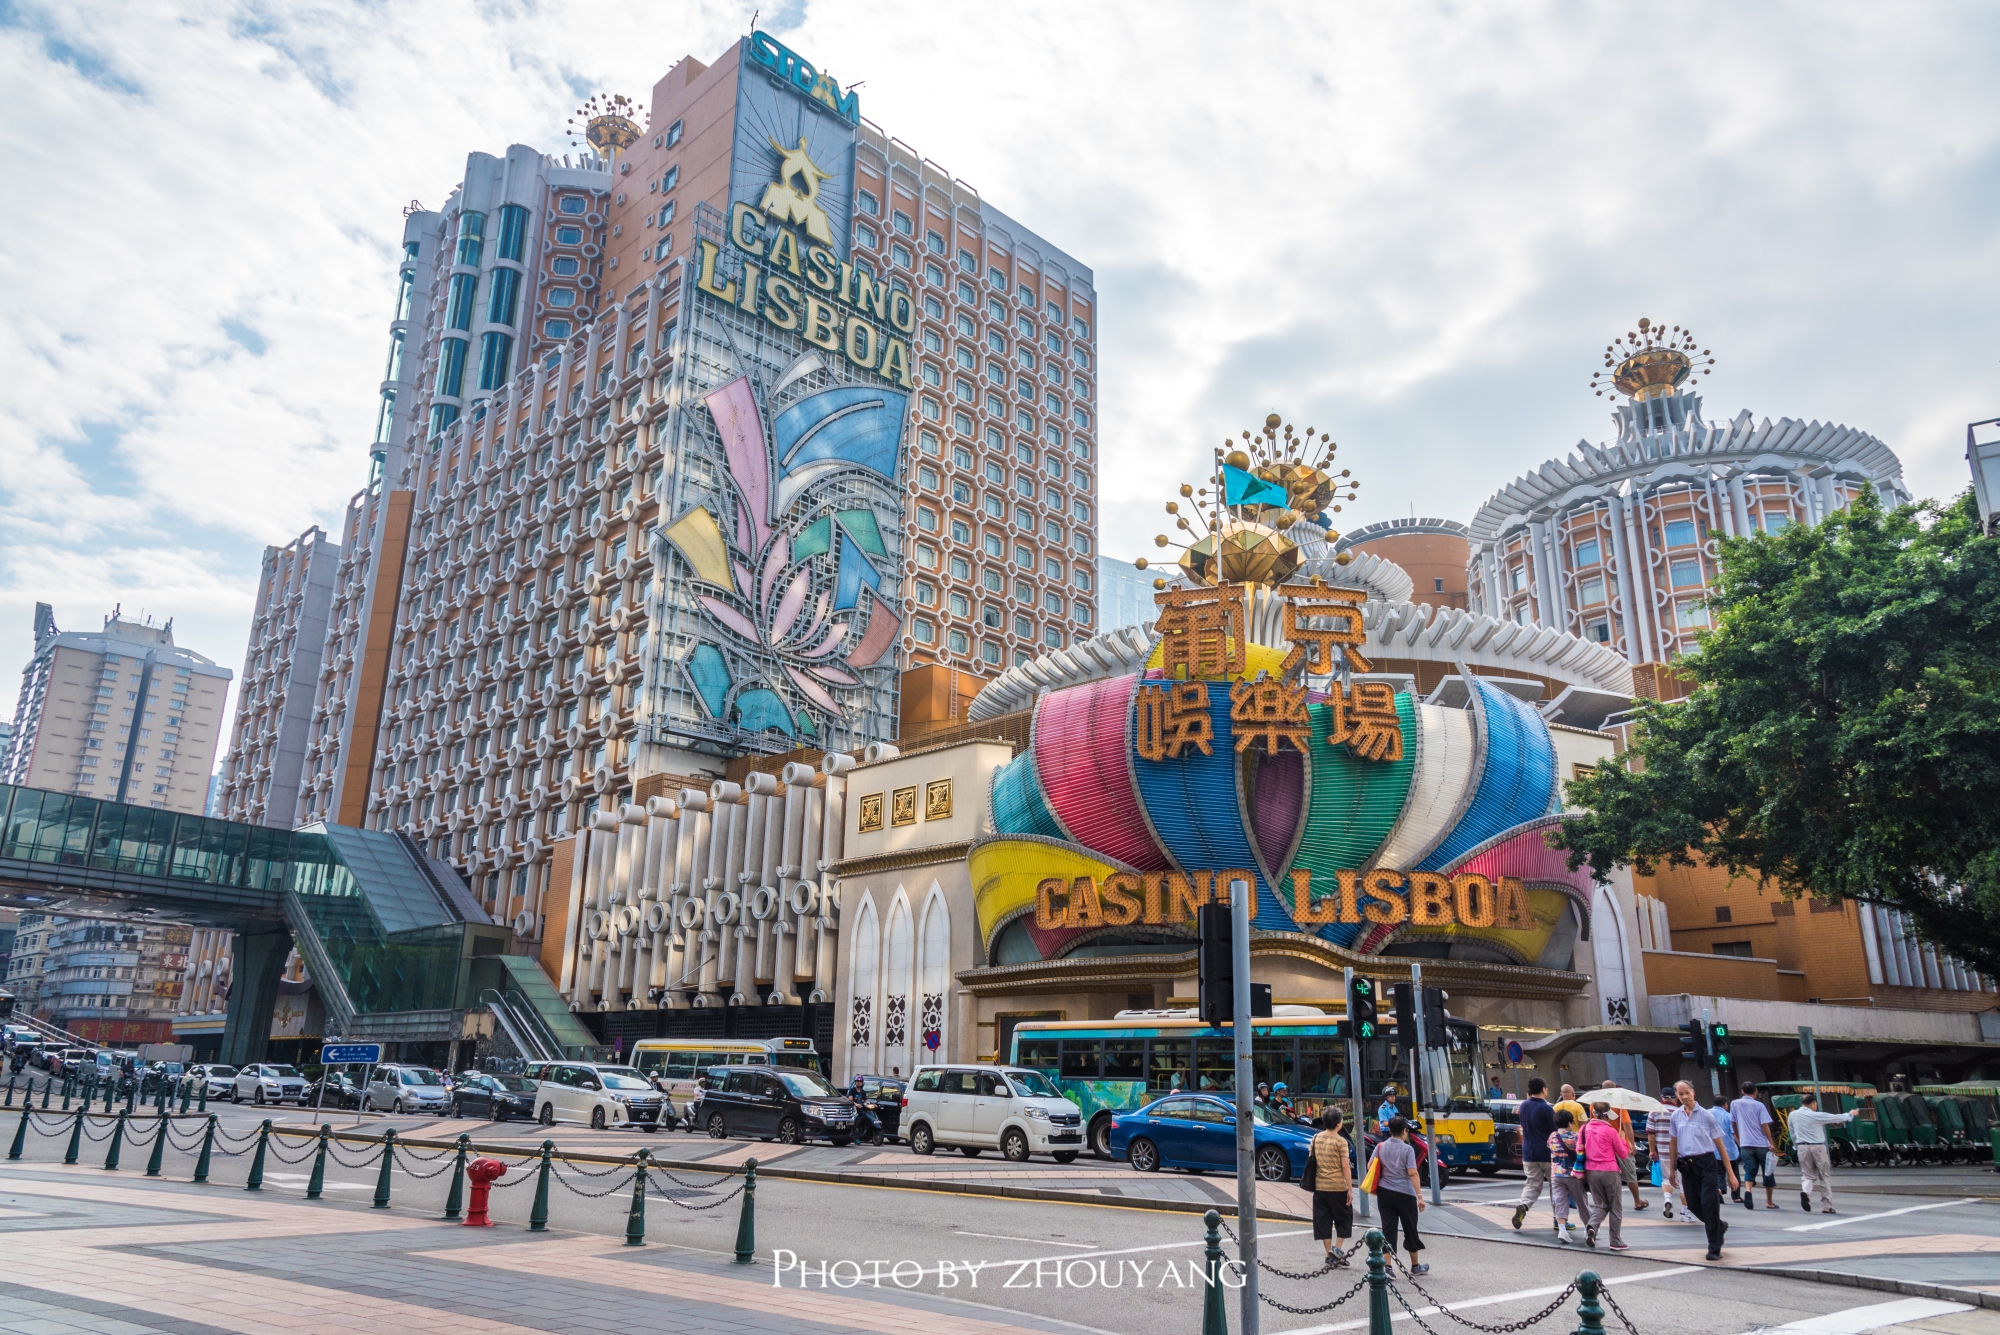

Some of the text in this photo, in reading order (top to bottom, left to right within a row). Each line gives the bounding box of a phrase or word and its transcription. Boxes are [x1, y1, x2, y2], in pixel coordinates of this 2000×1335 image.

[696, 239, 915, 392] LISBOA
[728, 200, 917, 336] CASINO
[1154, 579, 1374, 679] 葡京
[1035, 868, 1537, 930] CASINO LISBOA
[1357, 983, 1369, 994] 42
